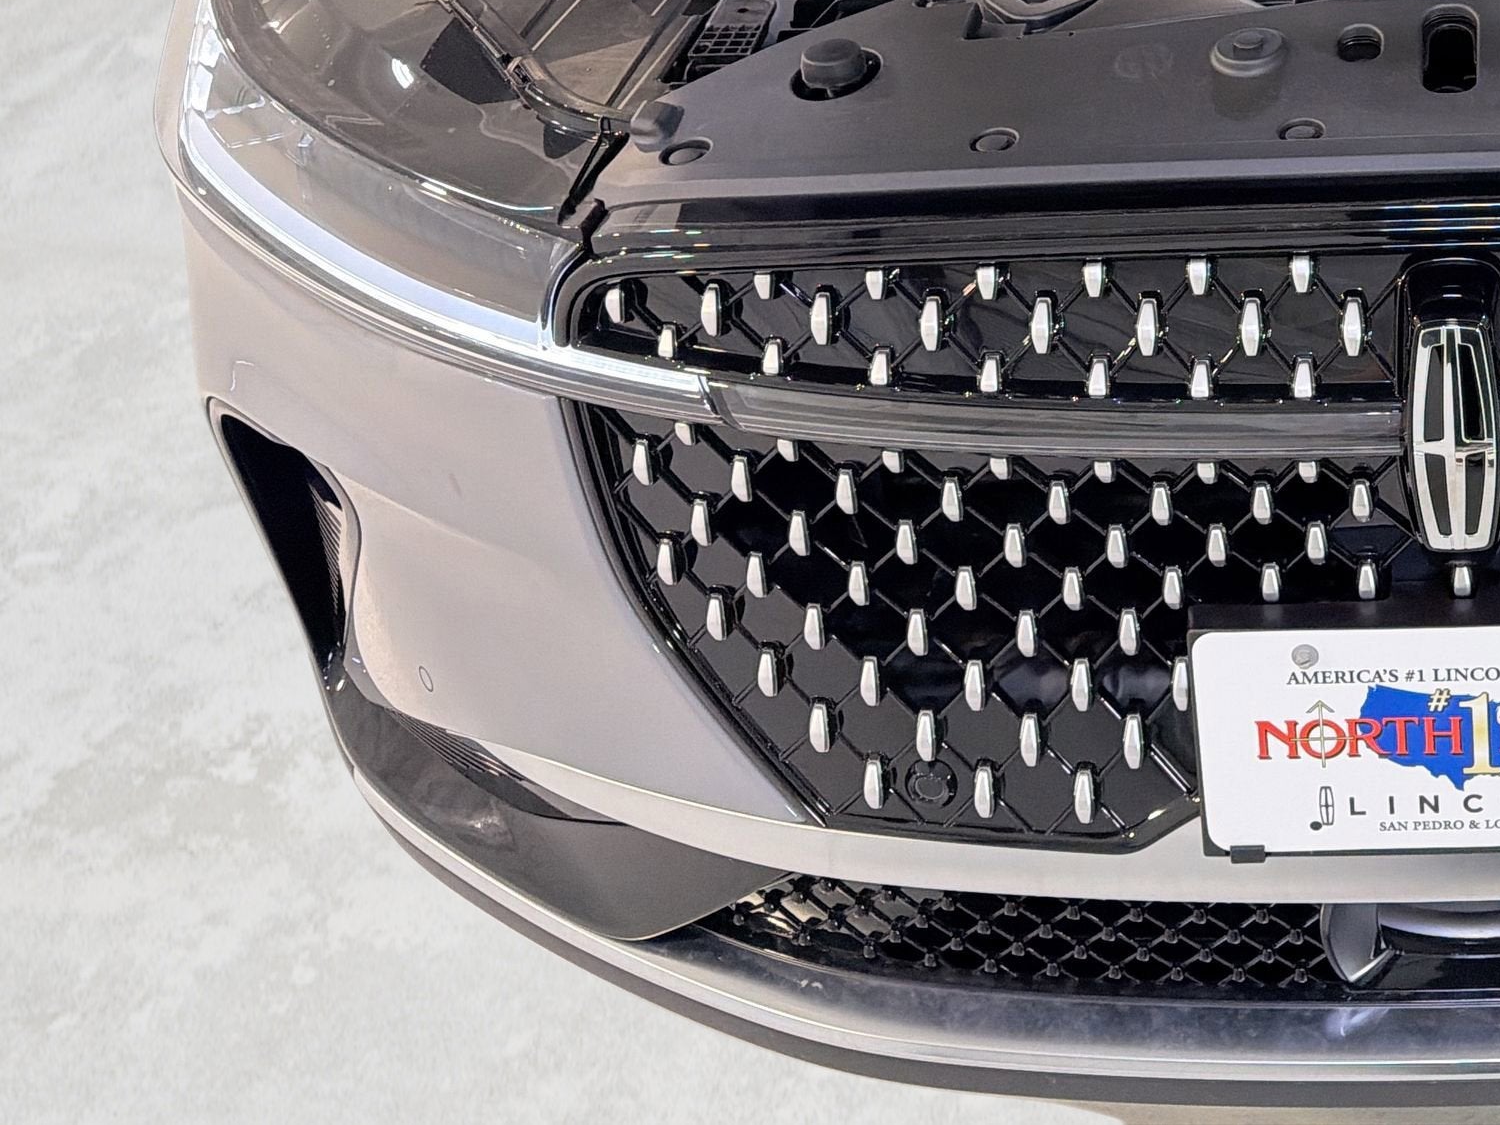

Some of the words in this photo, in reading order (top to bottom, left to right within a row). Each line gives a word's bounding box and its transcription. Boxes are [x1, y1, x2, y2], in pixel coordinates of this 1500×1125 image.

[1286, 668, 1399, 685] AMERICA'S
[1404, 668, 1427, 683] #1
[1254, 714, 1465, 760] NORTH
[1379, 821, 1408, 832] SAN
[1412, 819, 1464, 831] PEDRO
[1468, 819, 1481, 830] &
